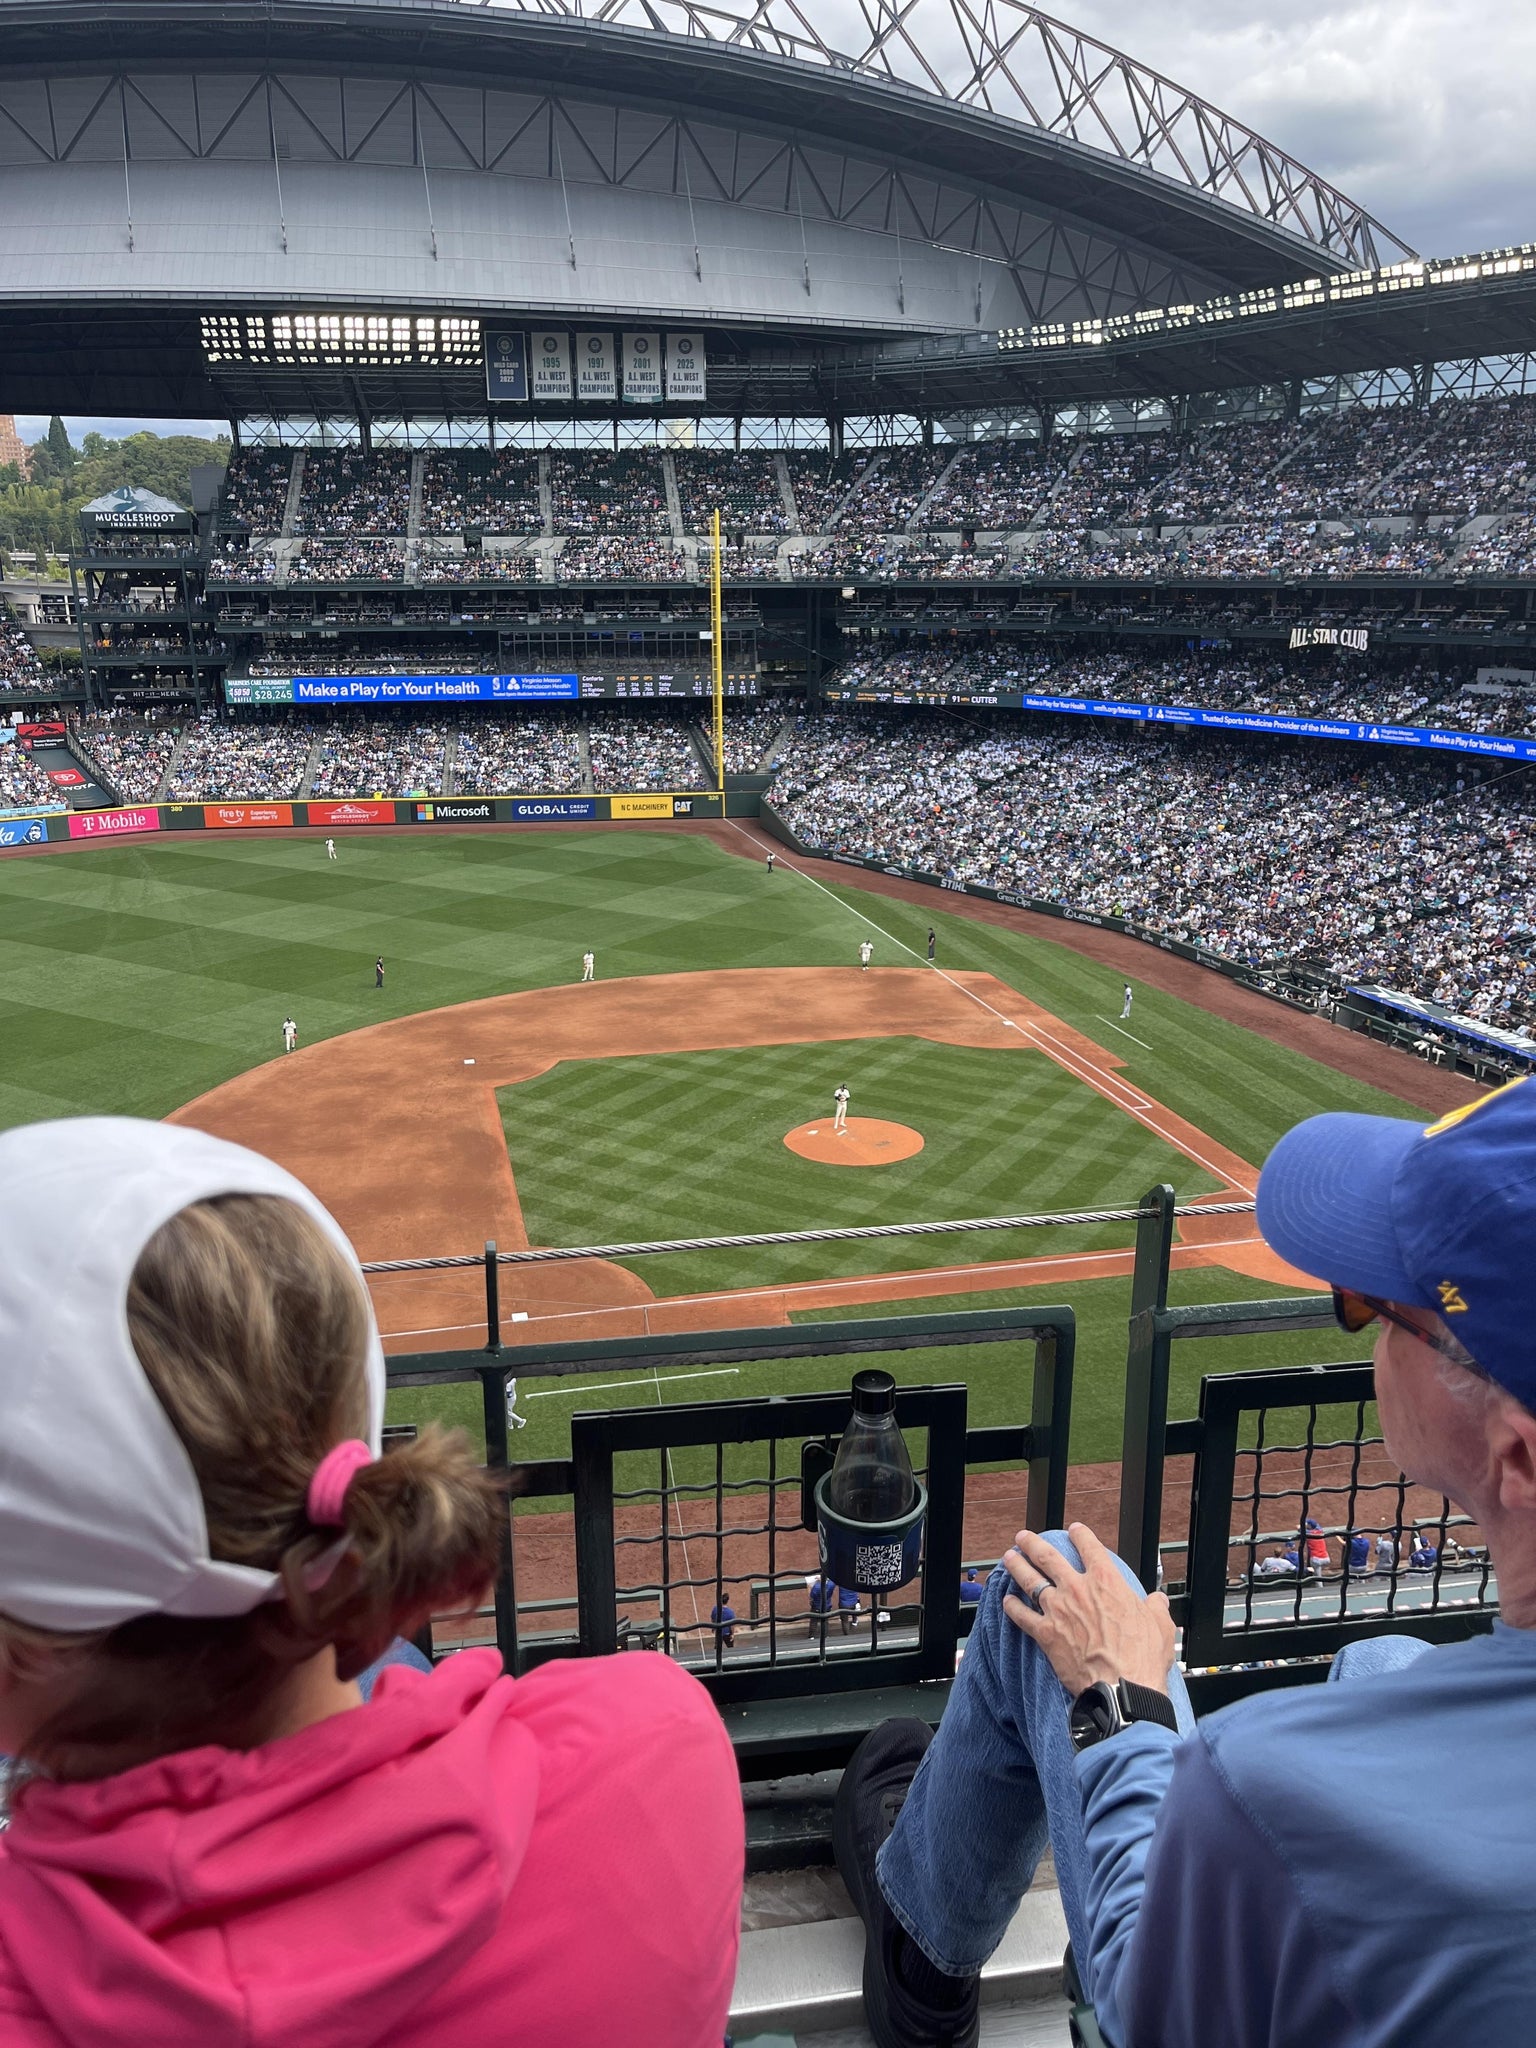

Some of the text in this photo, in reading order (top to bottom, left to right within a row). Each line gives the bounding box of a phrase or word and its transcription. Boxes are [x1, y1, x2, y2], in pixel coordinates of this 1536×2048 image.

[542, 357, 560, 368] 1995
[588, 357, 604, 368] 1997
[633, 357, 650, 368] 2001
[677, 358, 694, 369] 2025
[549, 371, 566, 380] WEST
[593, 371, 610, 380] WEST
[639, 371, 656, 380] WEST
[683, 372, 700, 381] WEST
[534, 383, 570, 393] CHAMPIONS
[580, 384, 614, 393] CHAMPIONS
[624, 384, 660, 393] CHAMPIONS
[669, 384, 703, 394] CHAMPIONS
[95, 513, 176, 522] MUCKLESHOOT
[1340, 628, 1369, 651] CLUB
[255, 690, 293, 700] $28,245
[300, 681, 480, 699] Make a Play for Your Health
[842, 691, 850, 699] 29
[952, 695, 960, 703] 91
[971, 696, 998, 704] CUTTER
[1202, 713, 1224, 724] Trusted
[1224, 715, 1244, 726] Sports
[1244, 717, 1273, 728] Medicine
[1273, 720, 1300, 731] Provider
[1308, 723, 1320, 732] the
[1320, 724, 1350, 735] Mariners
[1430, 734, 1451, 744] Make
[1455, 737, 1469, 748] Play
[1468, 739, 1480, 748] for
[1480, 740, 1494, 750] Your
[1493, 741, 1516, 753] Health
[437, 804, 490, 817] Microsoft
[518, 805, 567, 815] GLOBAL
[674, 801, 692, 812] CAT
[219, 809, 245, 817] fire tv
[98, 813, 146, 829] Mobile
[940, 880, 967, 893] STIHL
[997, 892, 1032, 907] Great Clips
[1073, 912, 1102, 924] LEXUS
